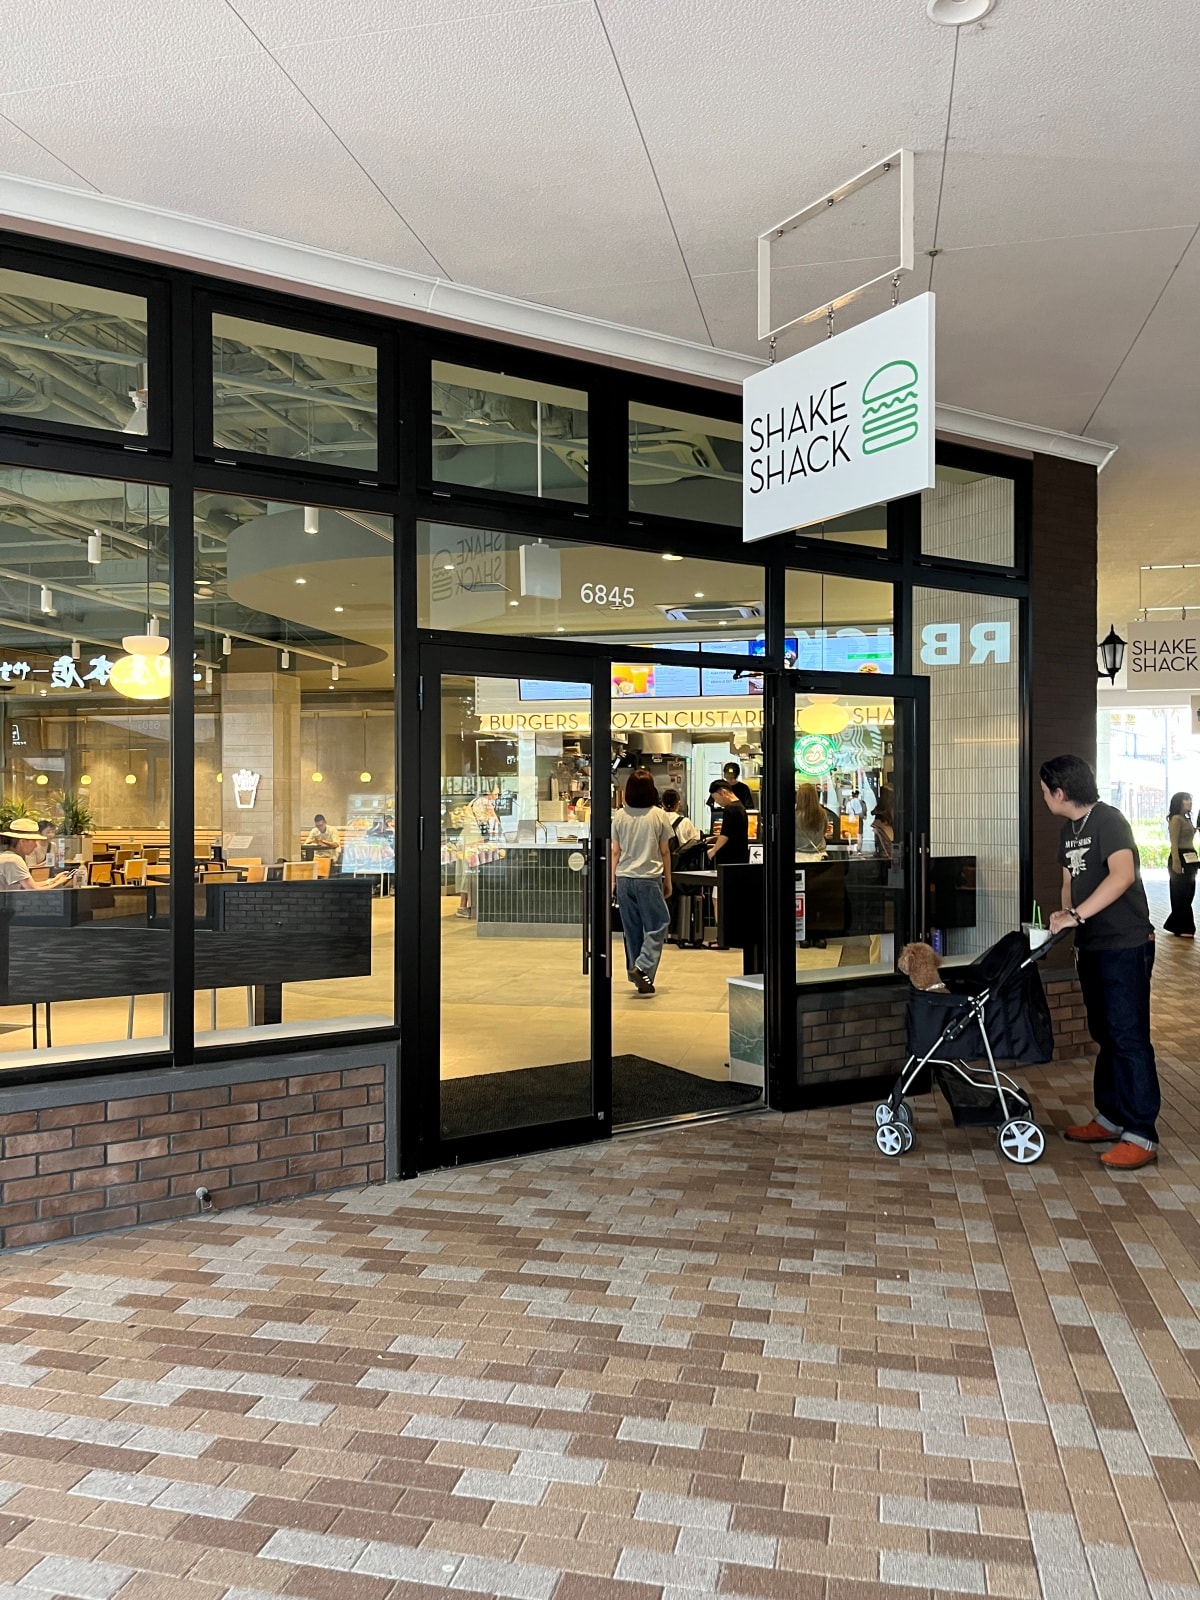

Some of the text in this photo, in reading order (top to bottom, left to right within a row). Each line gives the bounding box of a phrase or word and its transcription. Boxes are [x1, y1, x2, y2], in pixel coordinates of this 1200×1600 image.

[749, 380, 848, 453] SHAKE
[749, 424, 852, 494] SHACK
[580, 582, 635, 608] 6845
[1132, 638, 1197, 656] SHAKE
[1132, 655, 1199, 673] SHACK
[489, 713, 579, 731] BURGERS
[589, 712, 668, 730] OZEN
